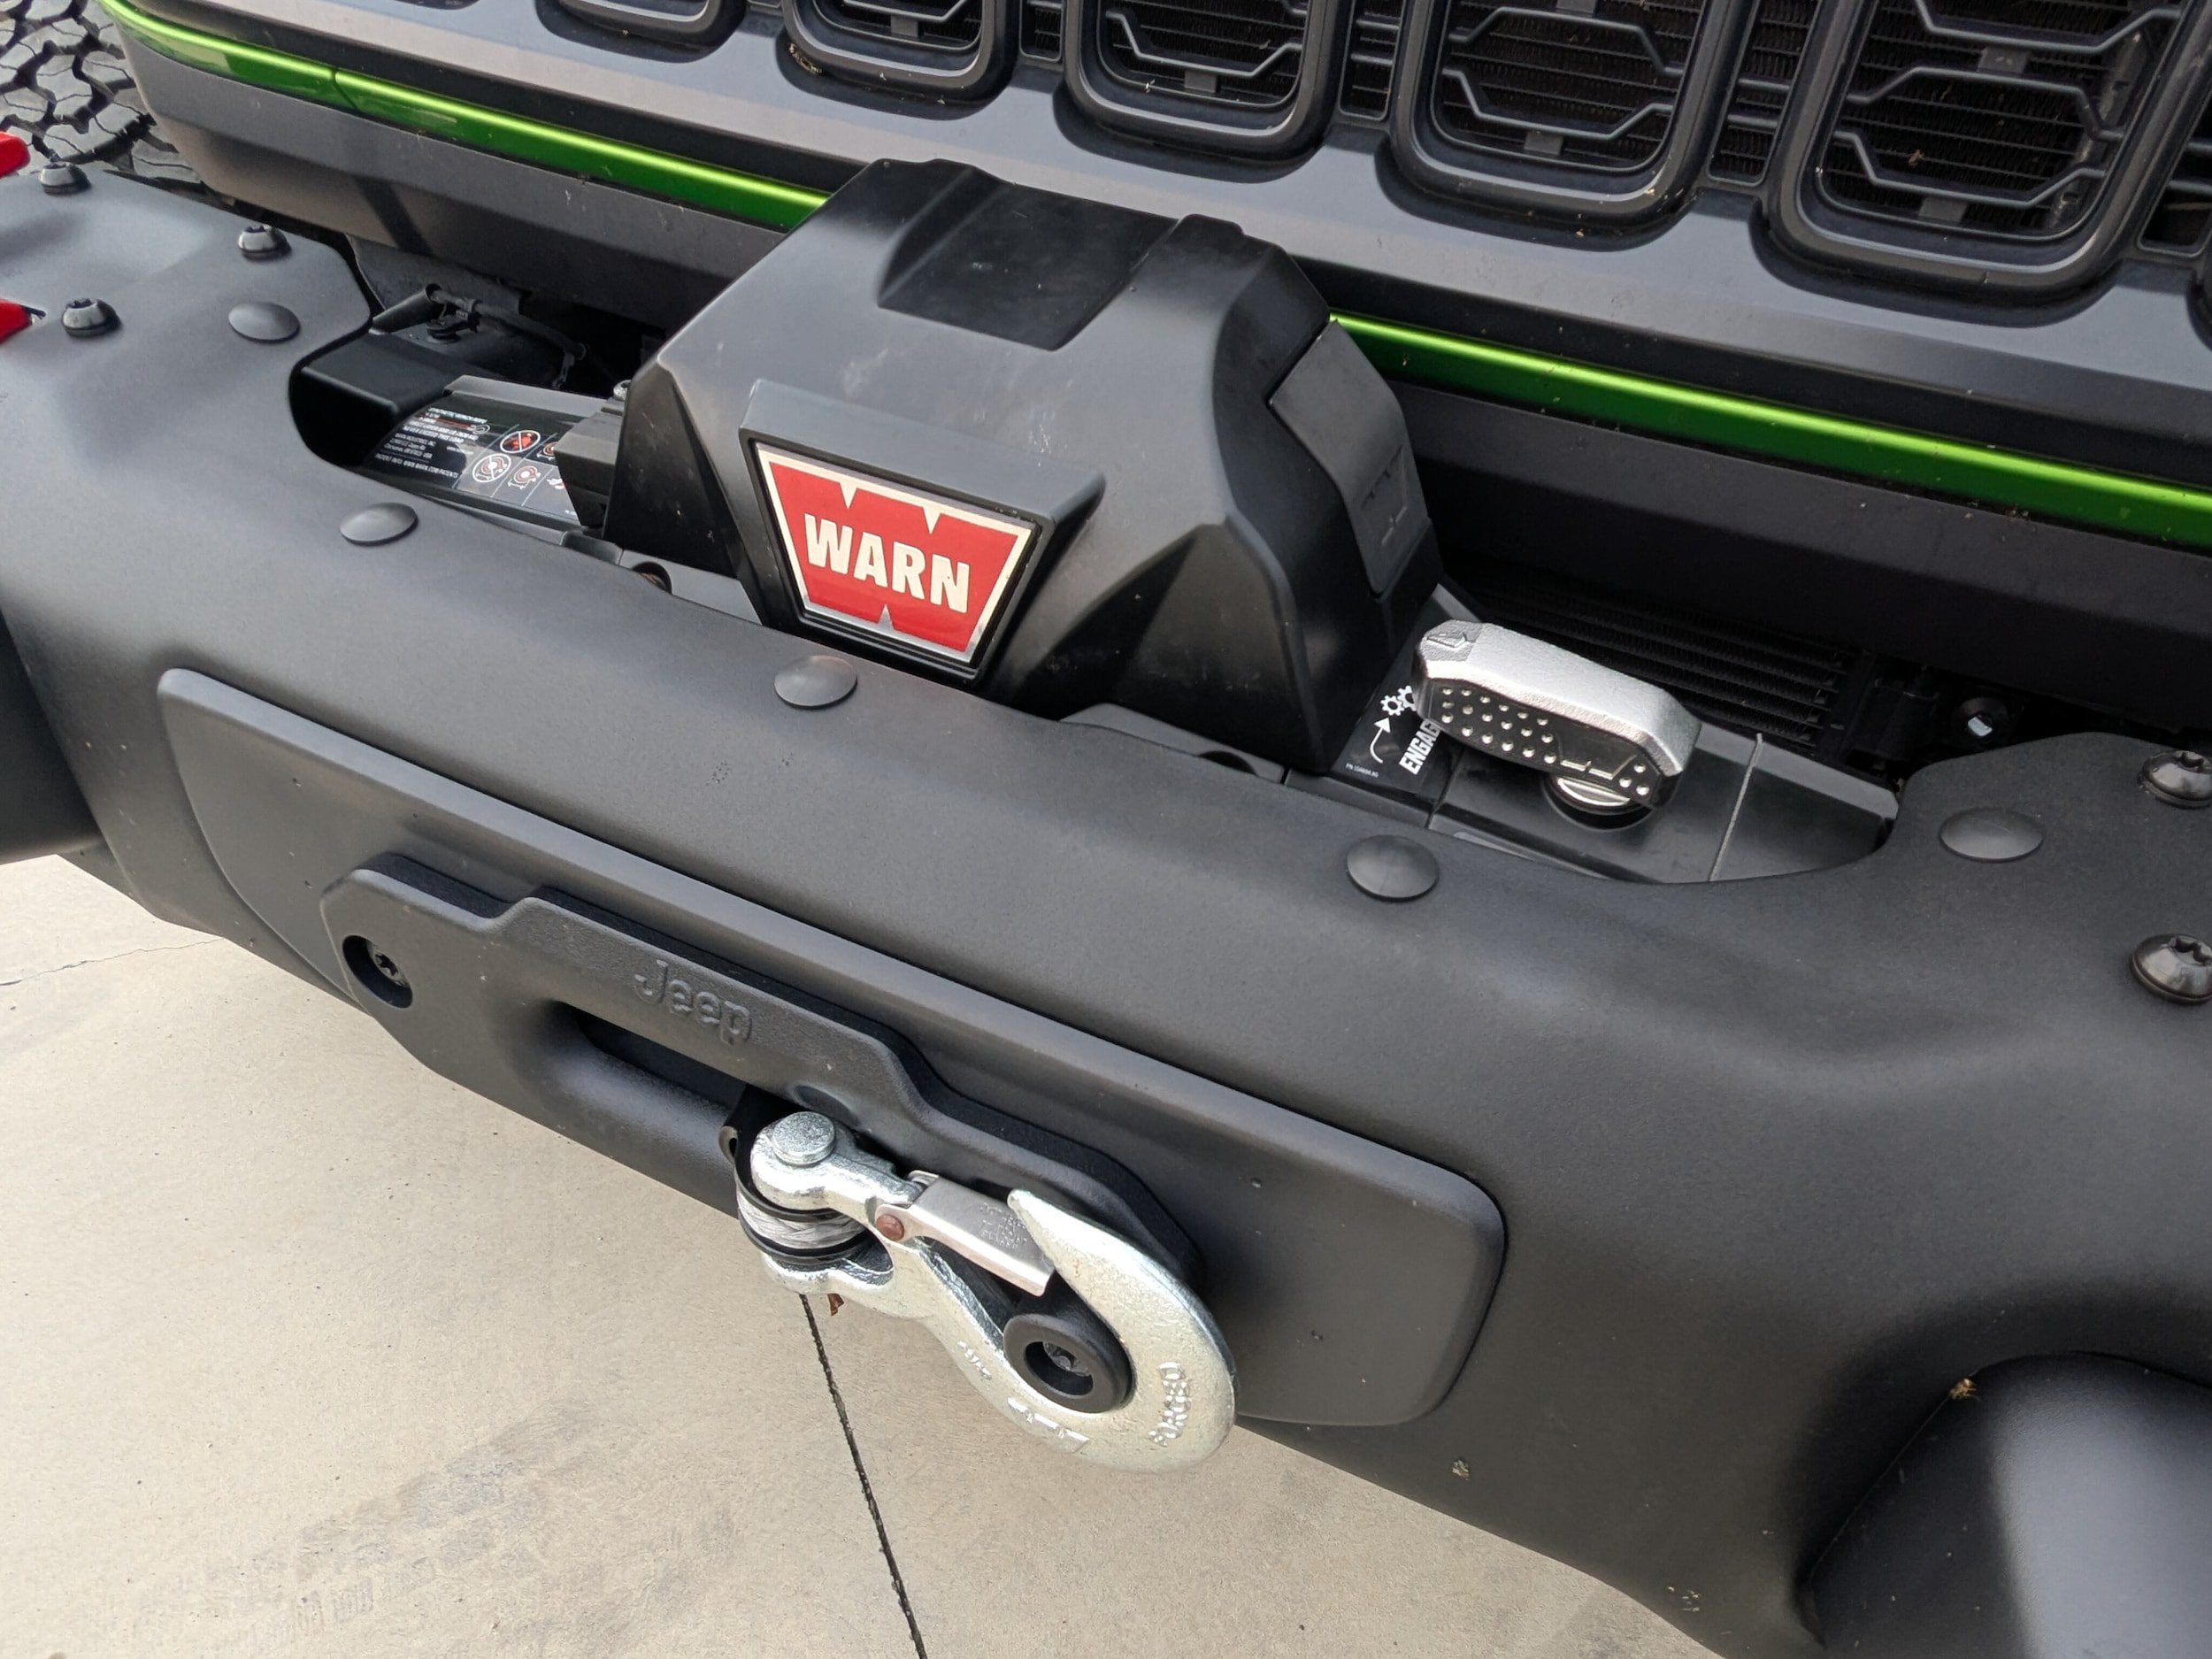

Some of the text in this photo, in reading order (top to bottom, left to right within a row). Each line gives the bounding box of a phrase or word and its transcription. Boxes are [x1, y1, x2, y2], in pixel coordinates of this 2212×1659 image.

[803, 512, 971, 614] WARN
[1398, 718, 1441, 775] ENGAG
[634, 958, 753, 1047] Jeep
